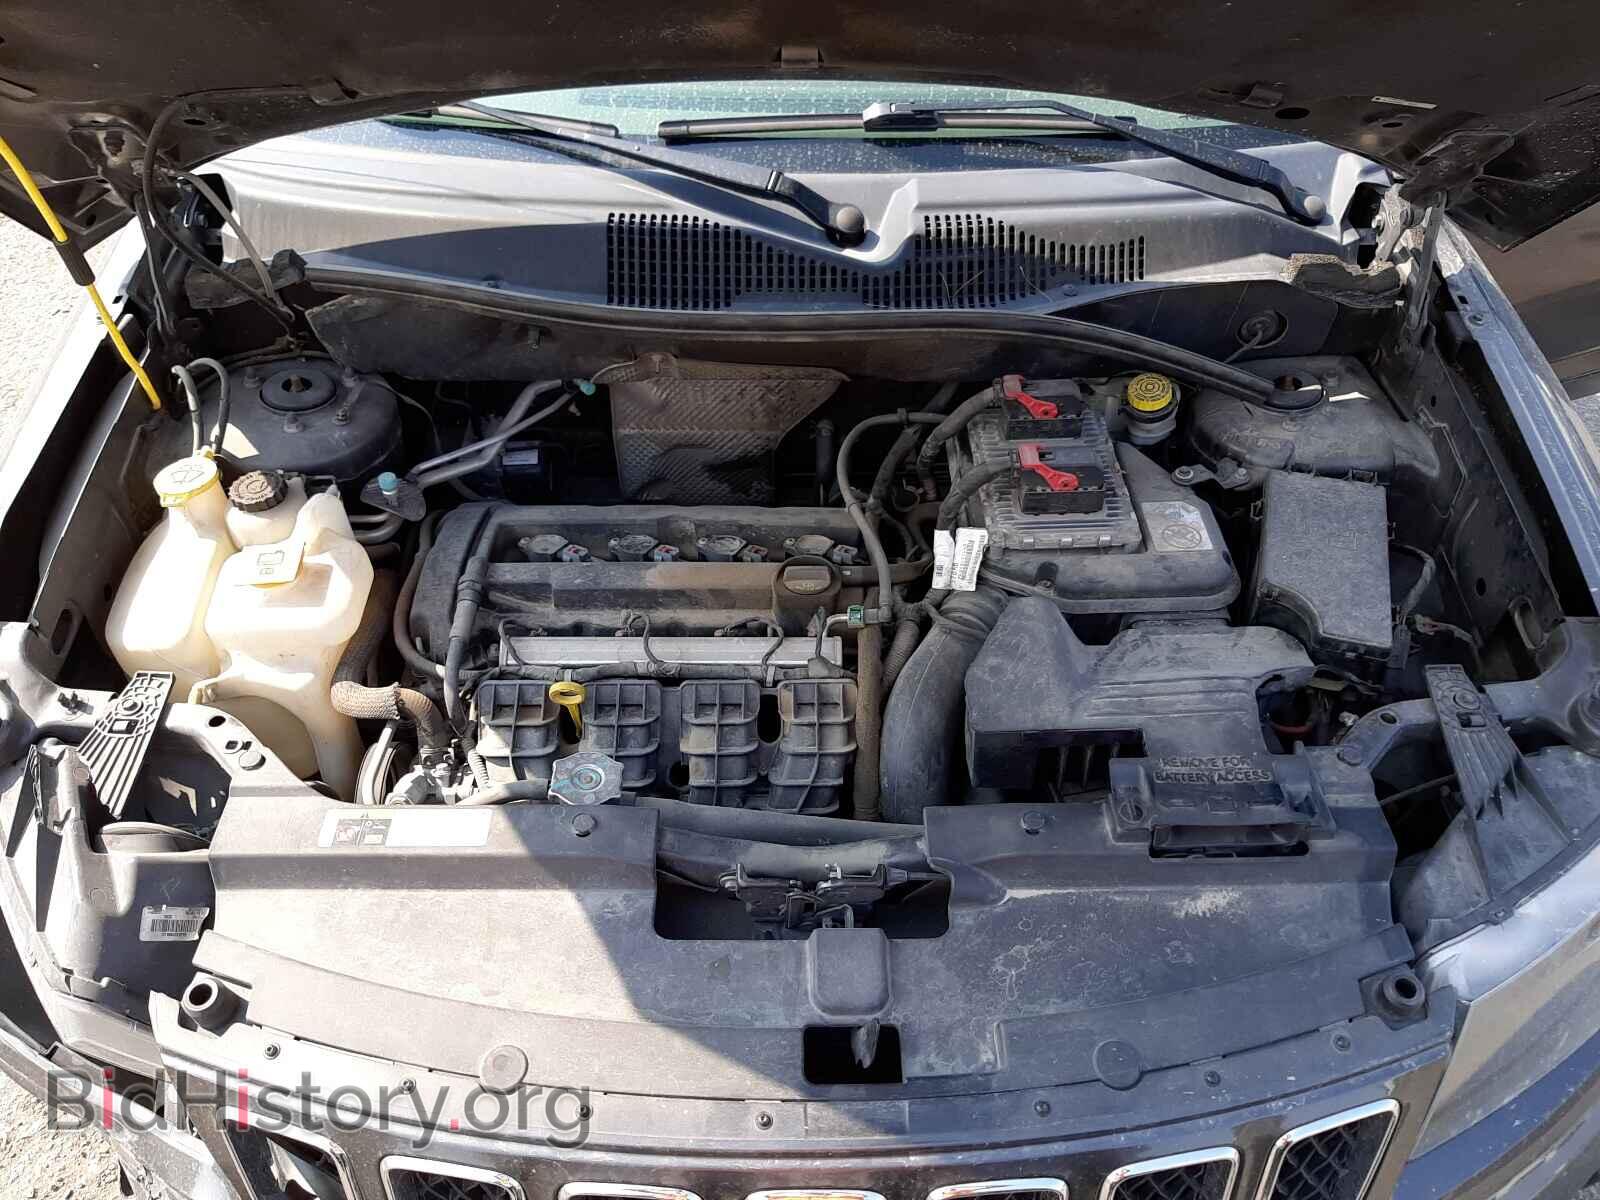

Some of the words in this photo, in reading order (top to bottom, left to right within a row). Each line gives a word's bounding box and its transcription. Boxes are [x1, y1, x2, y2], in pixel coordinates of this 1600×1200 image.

[1160, 757, 1220, 769] REMOVE
[1222, 756, 1250, 768] FOR
[1154, 770, 1214, 784] BATTERY
[1215, 769, 1271, 782] ACCESS
